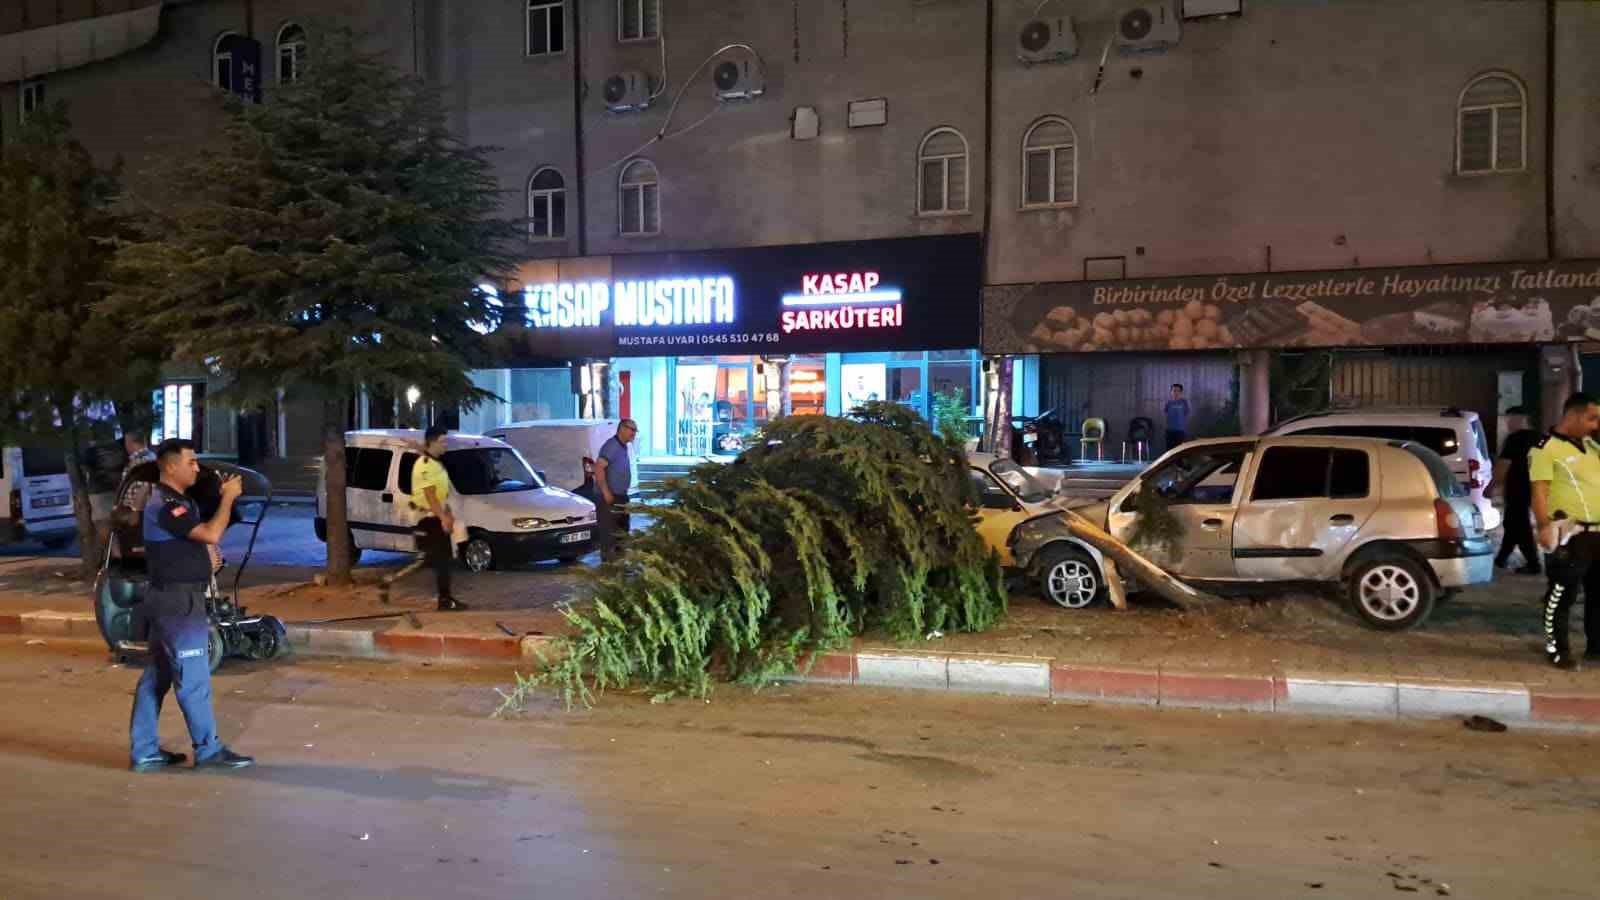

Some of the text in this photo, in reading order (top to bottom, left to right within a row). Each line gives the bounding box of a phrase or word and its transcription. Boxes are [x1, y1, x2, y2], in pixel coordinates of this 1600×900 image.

[802, 271, 880, 296] KASAP
[1093, 285, 1204, 304] Birbirinden
[1211, 277, 1256, 302] Özel
[1261, 276, 1375, 301] Lezzetlerle
[1381, 273, 1501, 298] Hayatınızı
[524, 276, 735, 328] KASAP MUSTAFA
[781, 303, 903, 334] ŞARKÜTERİ
[618, 335, 666, 345] MUSTAFA
[667, 335, 695, 345] UYAR
[701, 334, 728, 344] 0545
[730, 334, 749, 344] 510
[751, 333, 764, 343] 47
